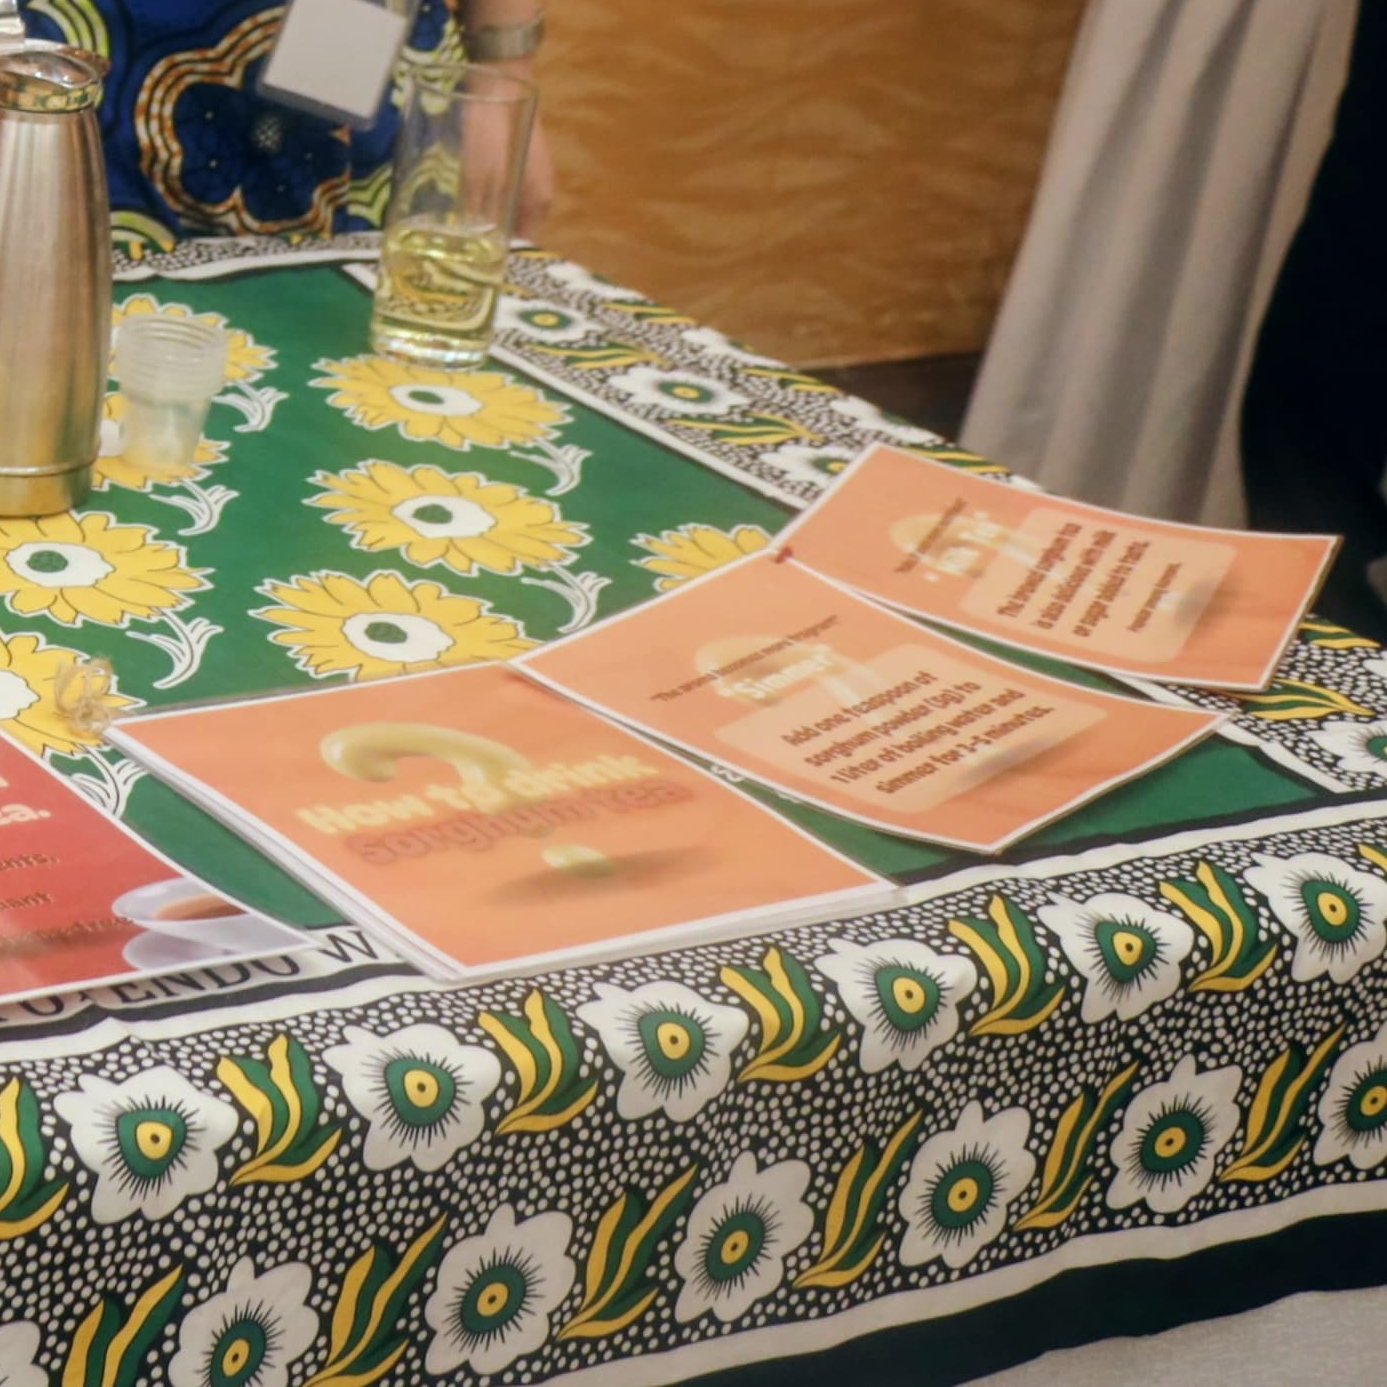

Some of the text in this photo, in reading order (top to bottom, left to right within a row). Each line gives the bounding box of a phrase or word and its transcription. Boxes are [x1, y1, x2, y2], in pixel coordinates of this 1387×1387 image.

[781, 670, 939, 748] Add one teaspoon of
[804, 730, 879, 767] sorghum
[871, 702, 933, 738] powder
[953, 680, 982, 695] to
[838, 757, 882, 780] liter
[878, 747, 904, 764] of
[893, 725, 958, 755] boiling
[947, 702, 996, 729] water
[989, 687, 1026, 707] and
[297, 752, 660, 834] How to drink
[876, 761, 939, 795] simmer
[928, 743, 964, 765] for
[18, 955, 300, 1016] UENDO
